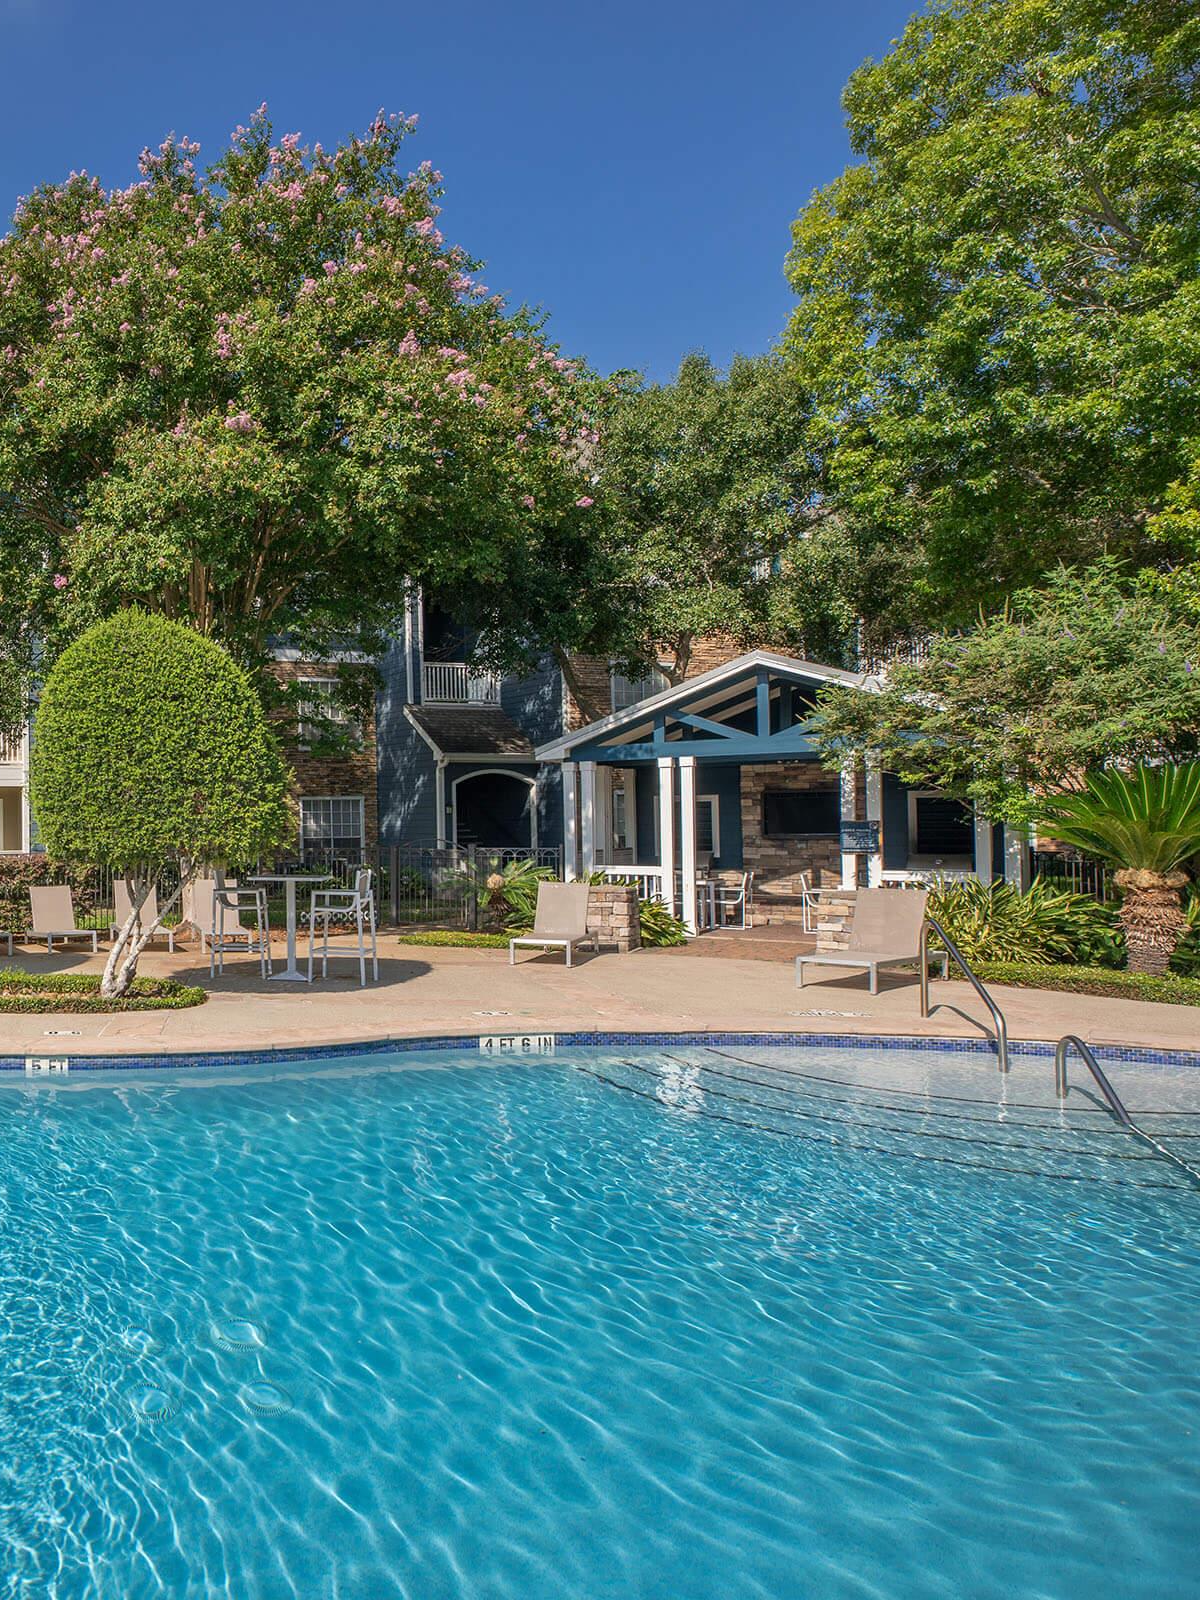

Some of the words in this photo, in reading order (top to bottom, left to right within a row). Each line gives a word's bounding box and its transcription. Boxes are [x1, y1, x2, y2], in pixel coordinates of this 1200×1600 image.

[485, 1038, 493, 1047] 4
[499, 1037, 516, 1047] FT
[521, 1037, 531, 1047] 6
[538, 1036, 552, 1047] IN
[31, 1059, 41, 1070] 5
[49, 1059, 66, 1070] FT
